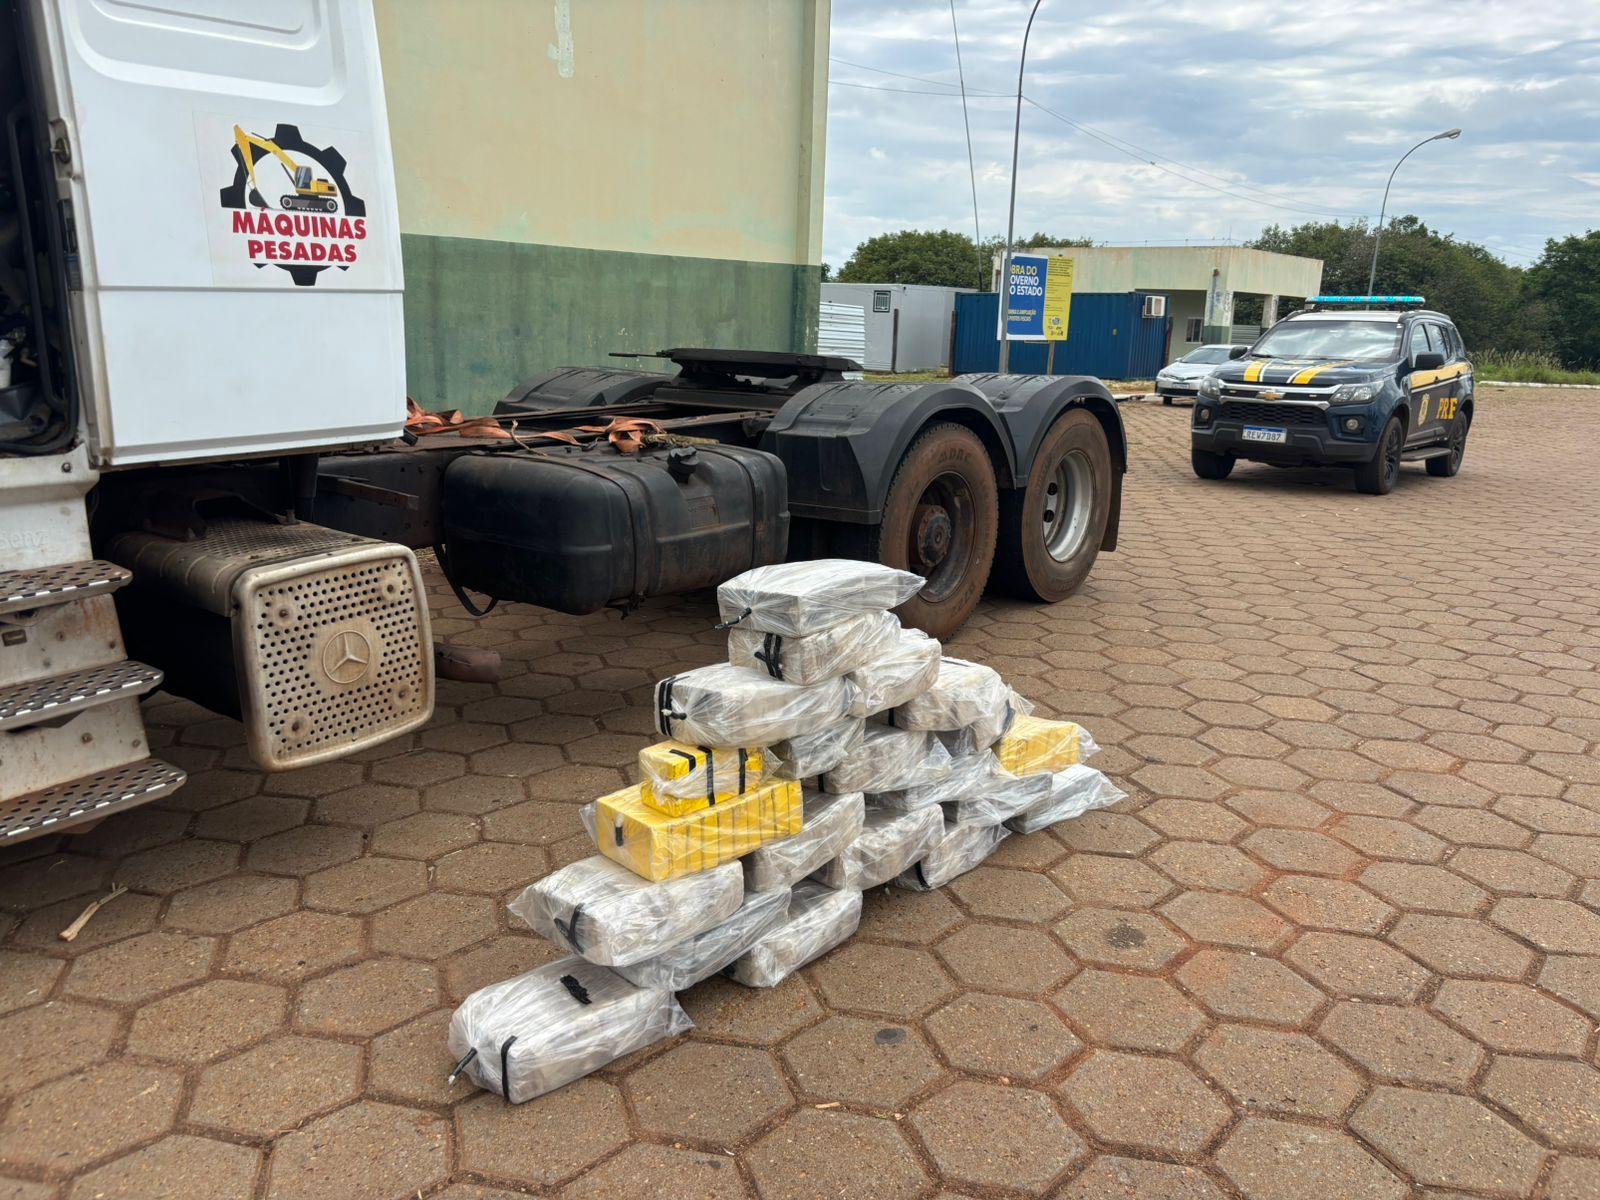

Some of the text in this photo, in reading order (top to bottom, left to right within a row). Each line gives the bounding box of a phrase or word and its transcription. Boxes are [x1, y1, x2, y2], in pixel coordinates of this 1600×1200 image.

[232, 207, 367, 240] MÁQUINAS
[247, 239, 357, 262] PESADAS
[1010, 264, 1025, 275] BRA
[1026, 265, 1038, 275] DO
[1010, 275, 1040, 286] OVERNO
[1009, 285, 1017, 295] O
[1016, 286, 1043, 296] ESTADO
[1435, 397, 1458, 420] PRF
